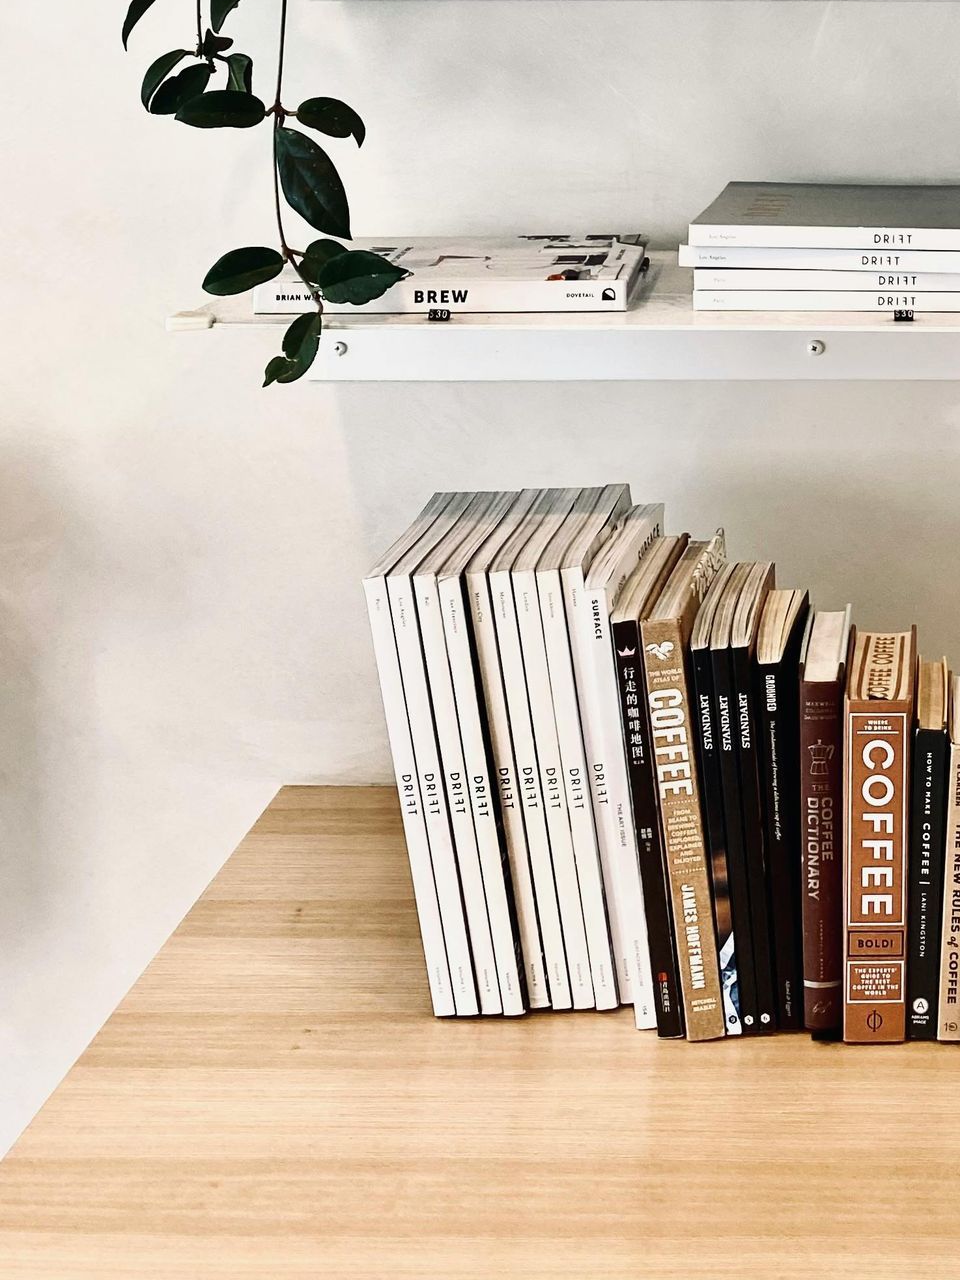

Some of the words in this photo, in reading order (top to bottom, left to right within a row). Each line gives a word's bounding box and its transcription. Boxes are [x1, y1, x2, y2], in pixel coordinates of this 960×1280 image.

[414, 289, 469, 304] BREW
[429, 309, 449, 319] $30
[894, 309, 914, 319] $30
[591, 599, 603, 641] SURFACE
[661, 668, 683, 676] WORLD
[872, 637, 896, 665] COFFEE
[653, 676, 671, 684] ATLAS
[765, 674, 777, 712] GROUNDED
[623, 666, 644, 758] 行走的咖啡地图
[699, 694, 714, 750] STANDART
[719, 695, 732, 751] STANDART
[738, 693, 751, 749] STANDART
[648, 688, 694, 800] COFFEE
[925, 776, 932, 787] TO
[807, 797, 820, 901] DICTIONARY
[821, 797, 834, 861] COFFEE
[861, 739, 895, 915] COFFEE
[921, 823, 931, 875] COFFEE
[681, 883, 699, 924] JAMES
[685, 925, 706, 990] HOFFMANN
[947, 937, 957, 948] of
[946, 951, 959, 1004] COFFEE
